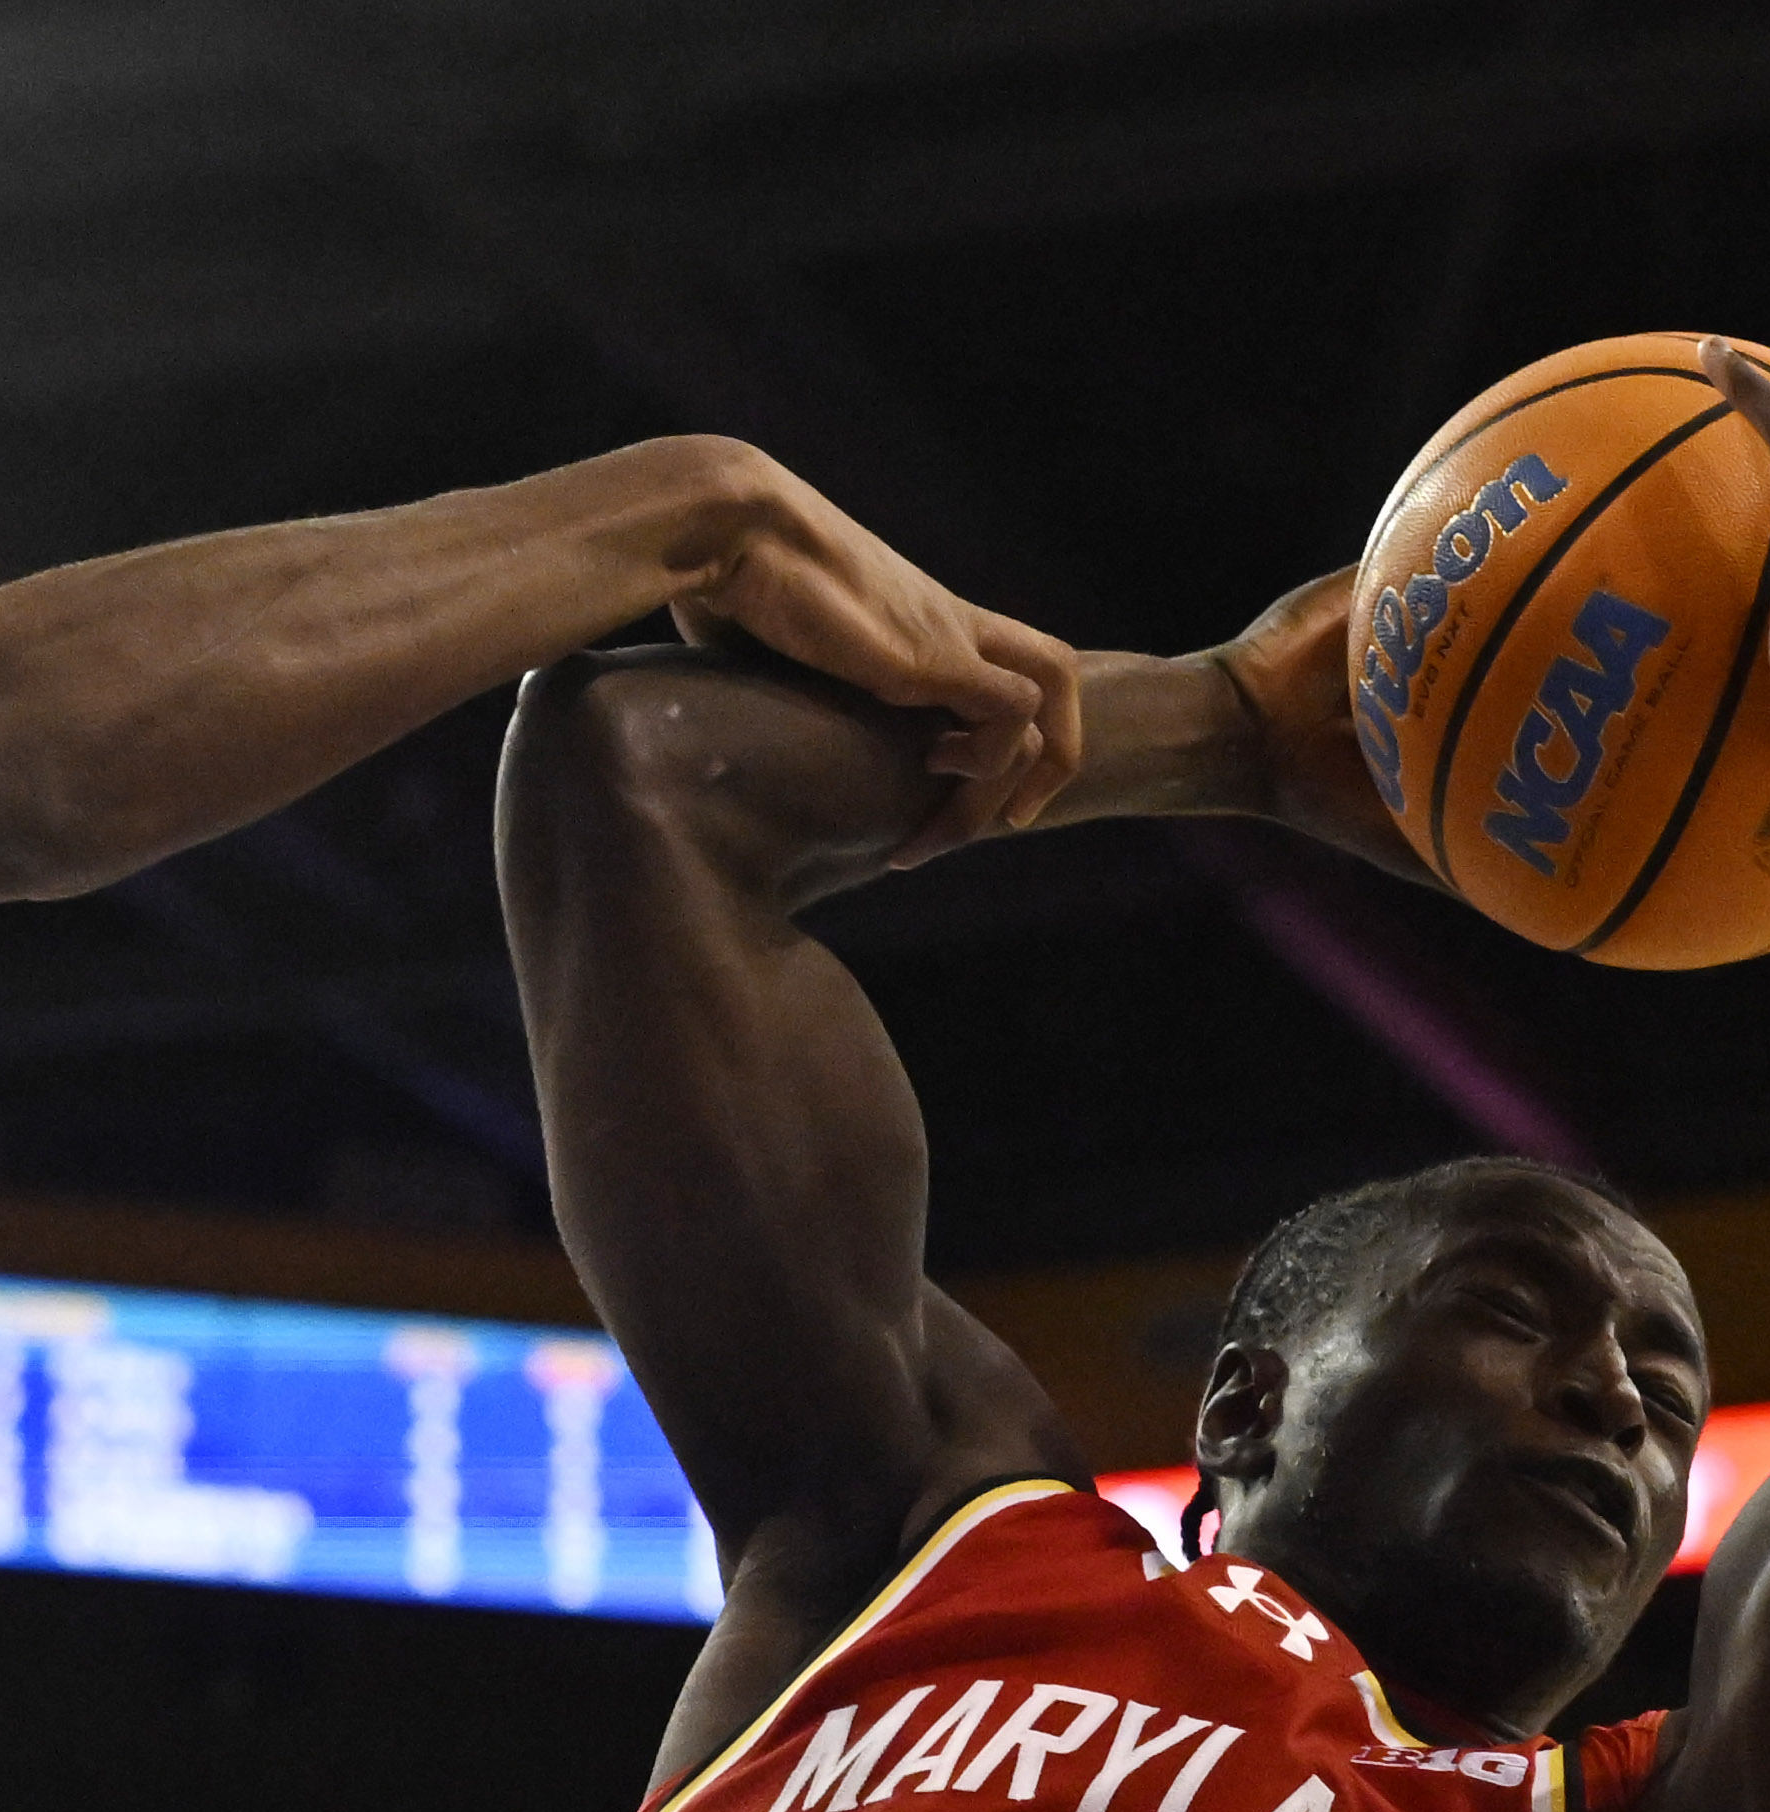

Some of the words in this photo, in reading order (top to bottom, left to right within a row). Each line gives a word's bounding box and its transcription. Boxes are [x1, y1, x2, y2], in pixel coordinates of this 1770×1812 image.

[1357, 453, 1570, 816] Wilson
[1434, 599, 1472, 662] NXT
[1643, 636, 1694, 708] BALL
[1481, 587, 1673, 878] NCAA
